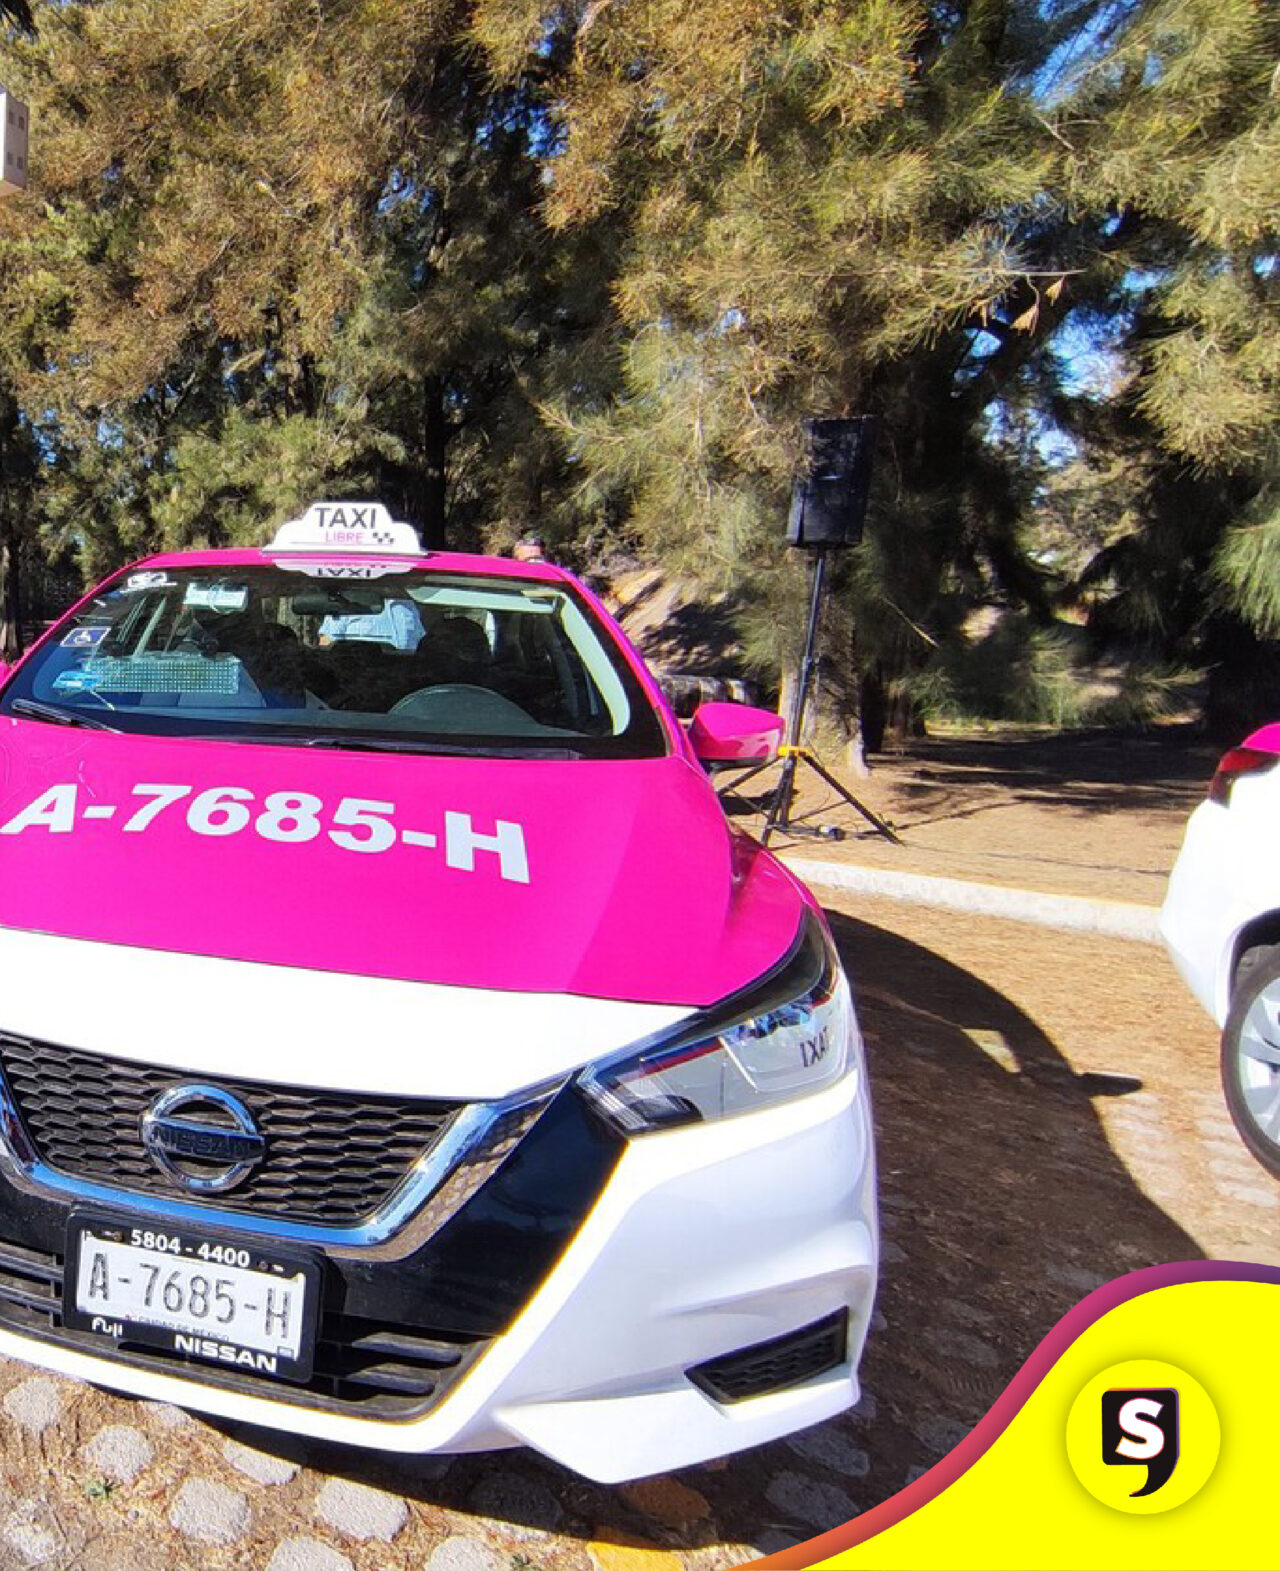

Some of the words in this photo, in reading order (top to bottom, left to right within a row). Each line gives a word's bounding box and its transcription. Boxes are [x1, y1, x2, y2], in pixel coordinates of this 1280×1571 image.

[314, 507, 377, 529] TAXI
[325, 532, 365, 544] LIBRE
[131, 1229, 181, 1254] 5804
[198, 1243, 251, 1268] 4400
[88, 1252, 291, 1339] A-7685-H
[174, 1334, 277, 1373] NISSAN
